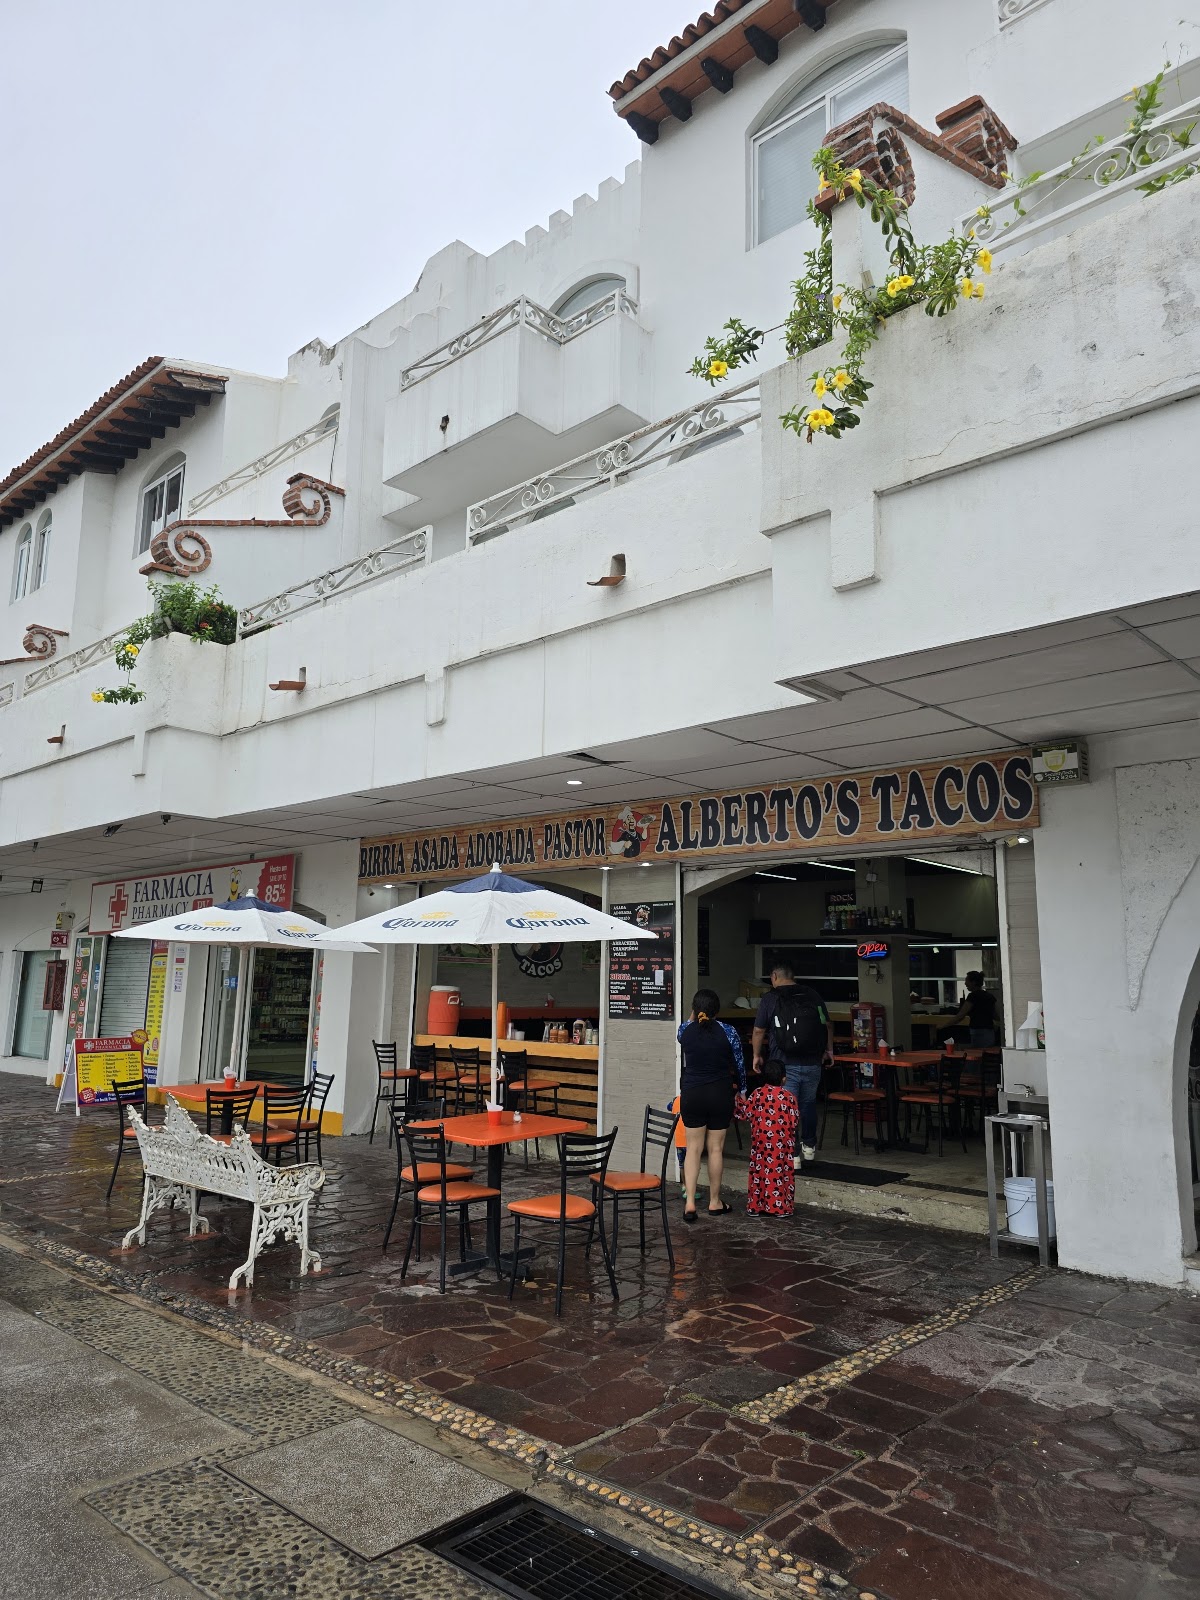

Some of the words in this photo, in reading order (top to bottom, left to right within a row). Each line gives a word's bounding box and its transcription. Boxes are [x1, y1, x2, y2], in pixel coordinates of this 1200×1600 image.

[654, 778, 861, 854] ALBERTO'S
[870, 755, 1035, 833] TACOS
[359, 841, 406, 878] BIRRIA
[410, 834, 460, 873] ASADA
[464, 826, 536, 869] ADOBADA
[543, 817, 606, 861] PASTOR
[133, 872, 214, 903] FARMACIA
[132, 901, 190, 920] PHARMACY
[174, 923, 242, 932] Corona
[382, 917, 460, 931] Corona
[505, 917, 591, 931] Corona
[857, 943, 888, 957] Open
[520, 958, 562, 976] TACOS
